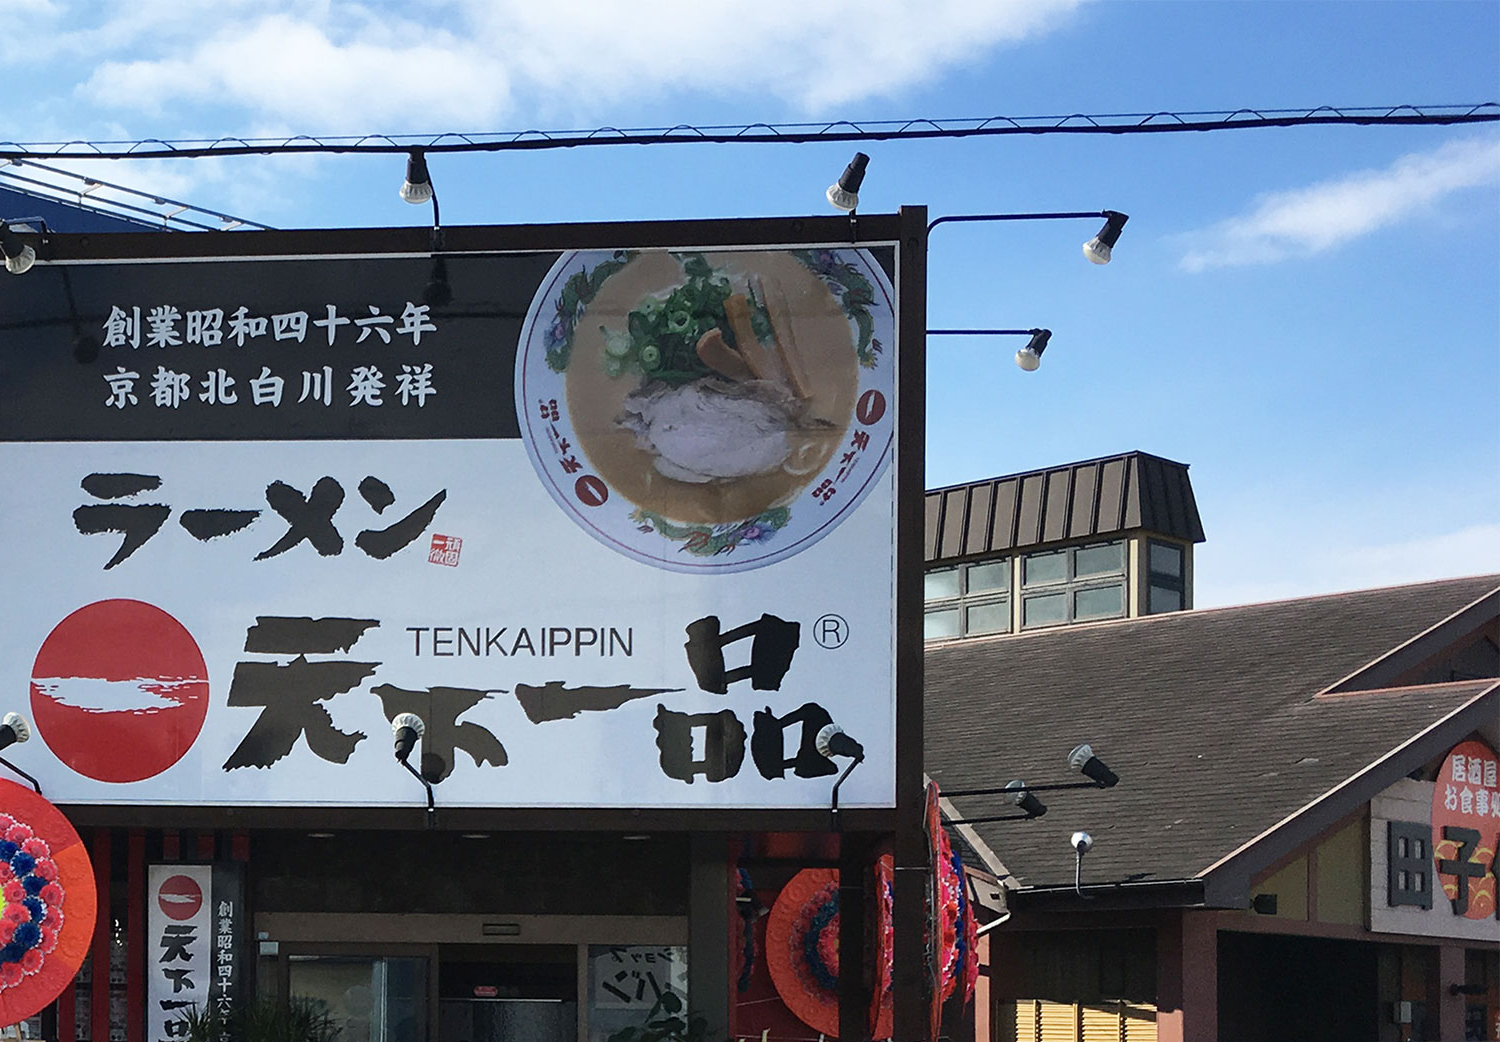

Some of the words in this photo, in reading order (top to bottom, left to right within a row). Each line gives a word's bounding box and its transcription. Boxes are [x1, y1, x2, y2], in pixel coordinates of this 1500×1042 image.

[102, 301, 437, 350] 創業昭和四十六年
[103, 363, 438, 410] 京都北白川発祥
[72, 472, 447, 571] ラーメン
[406, 626, 634, 657] TENKAIPPIN
[223, 612, 843, 785] 天下一品
[1387, 820, 1500, 920] 田子
